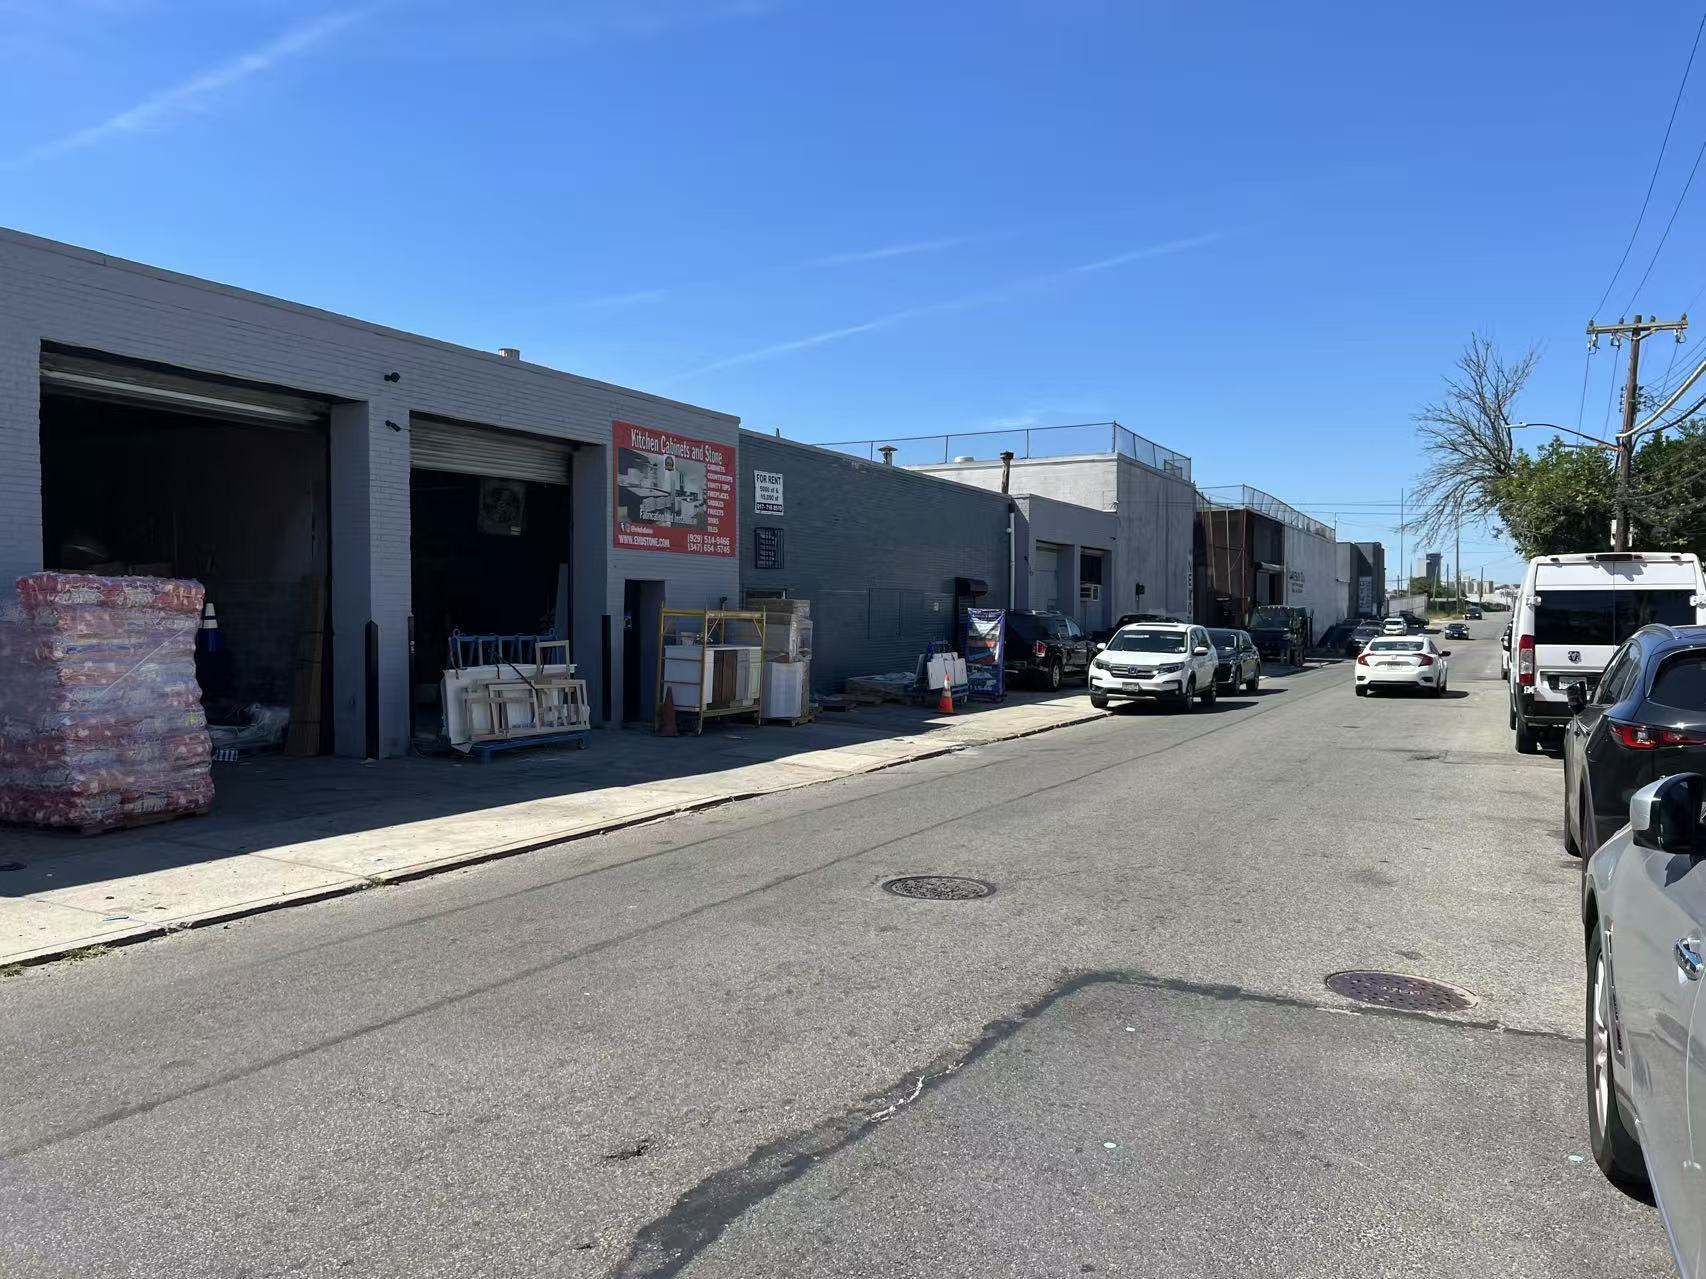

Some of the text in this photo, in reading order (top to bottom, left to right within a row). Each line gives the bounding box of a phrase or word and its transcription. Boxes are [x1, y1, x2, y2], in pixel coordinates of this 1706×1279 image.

[631, 429, 723, 464] Kitchen Cabinets and Stone
[756, 474, 782, 485] FOR RENT
[687, 533, 703, 544] (929)
[687, 542, 703, 553] (347)
